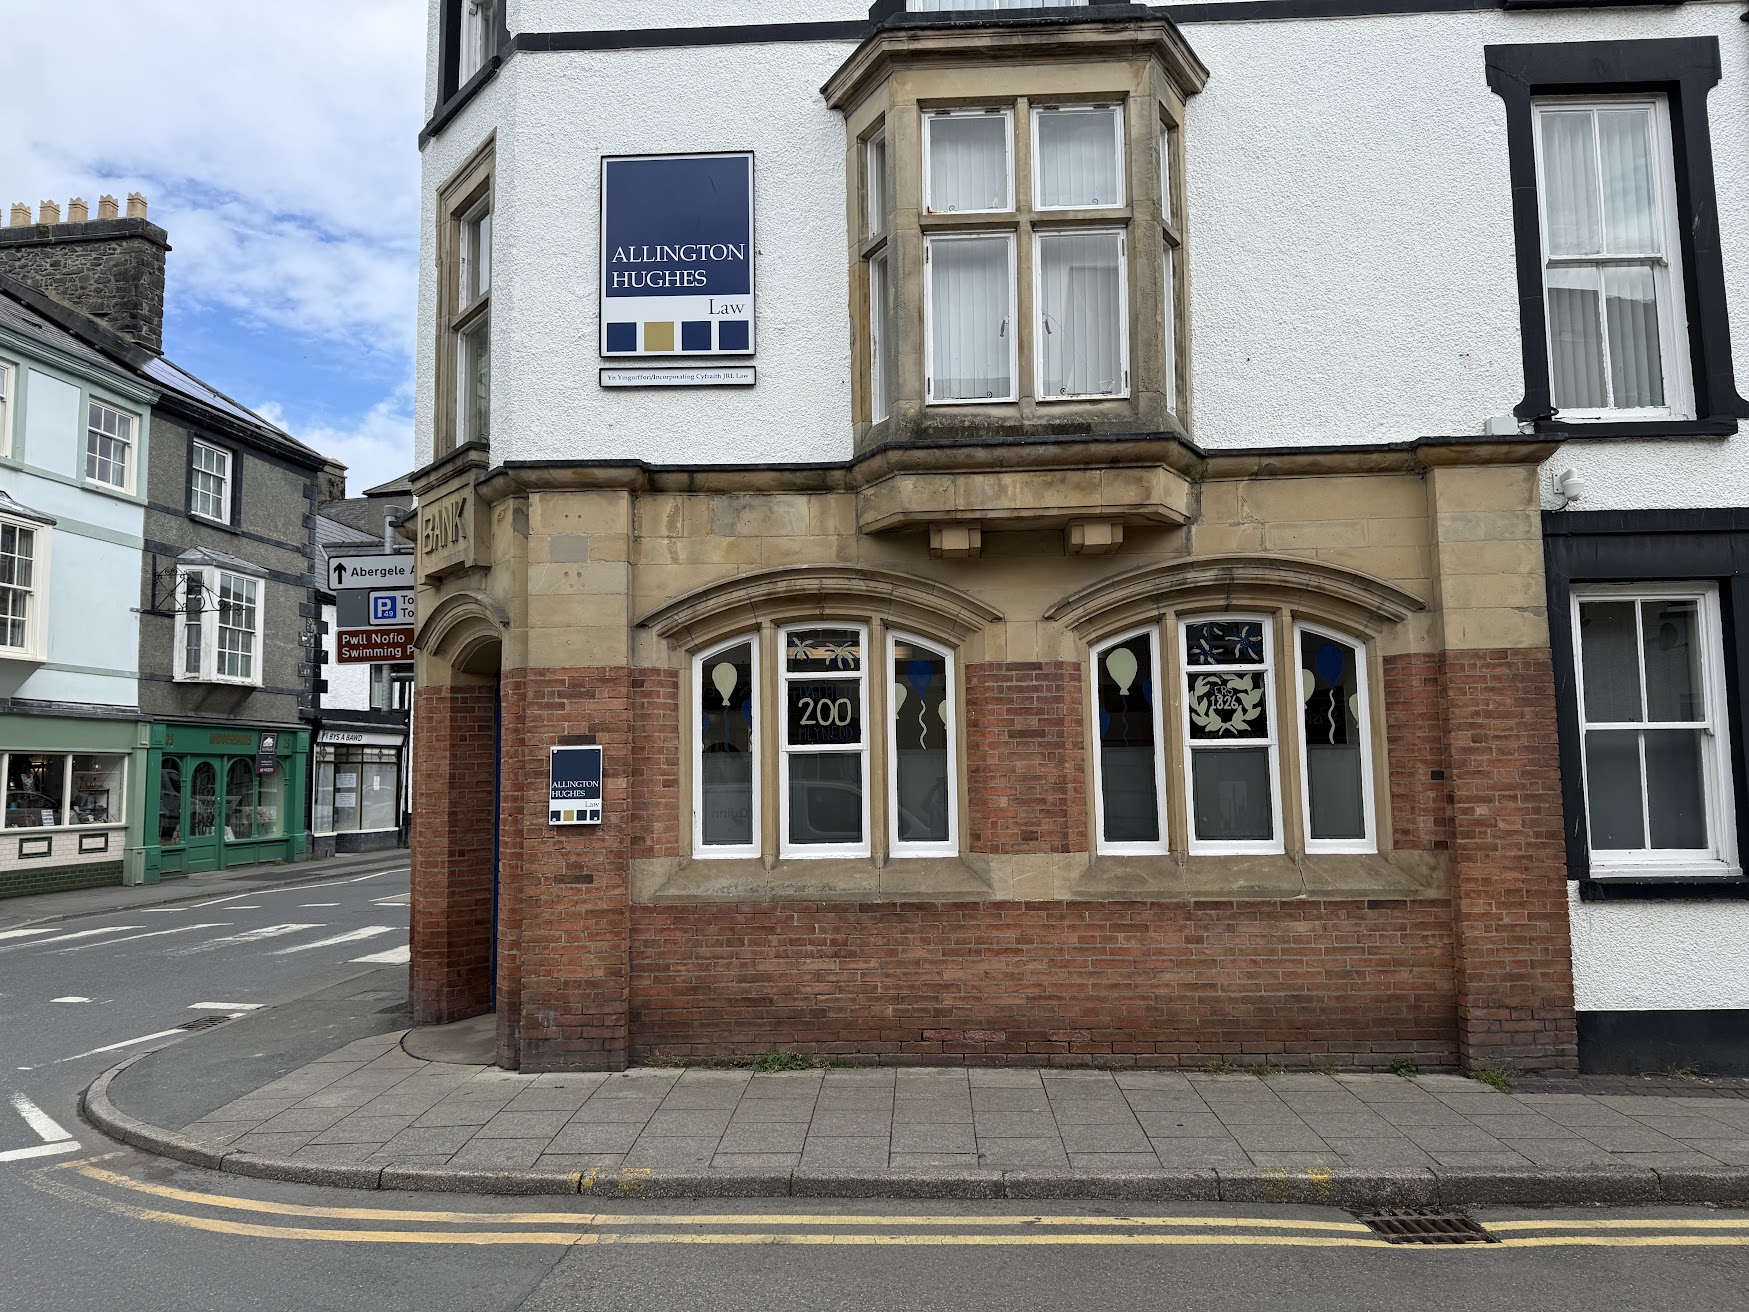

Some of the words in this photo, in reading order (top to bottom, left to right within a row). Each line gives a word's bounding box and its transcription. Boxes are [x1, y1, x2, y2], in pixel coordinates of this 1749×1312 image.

[611, 243, 746, 263] ALLINGTON
[611, 270, 707, 288] HUGHES
[708, 298, 746, 315] Law
[423, 497, 467, 555] BANK
[350, 565, 406, 578] Abergele
[342, 634, 368, 645] Pwll
[371, 632, 405, 644] Nofio
[341, 645, 402, 658] Swimming
[1214, 686, 1234, 696] ERS
[1210, 695, 1239, 710] 1826
[798, 697, 852, 726] 200
[329, 732, 341, 741] BYS
[552, 780, 599, 788] ALLINGTON
[551, 789, 586, 798] HUGHES
